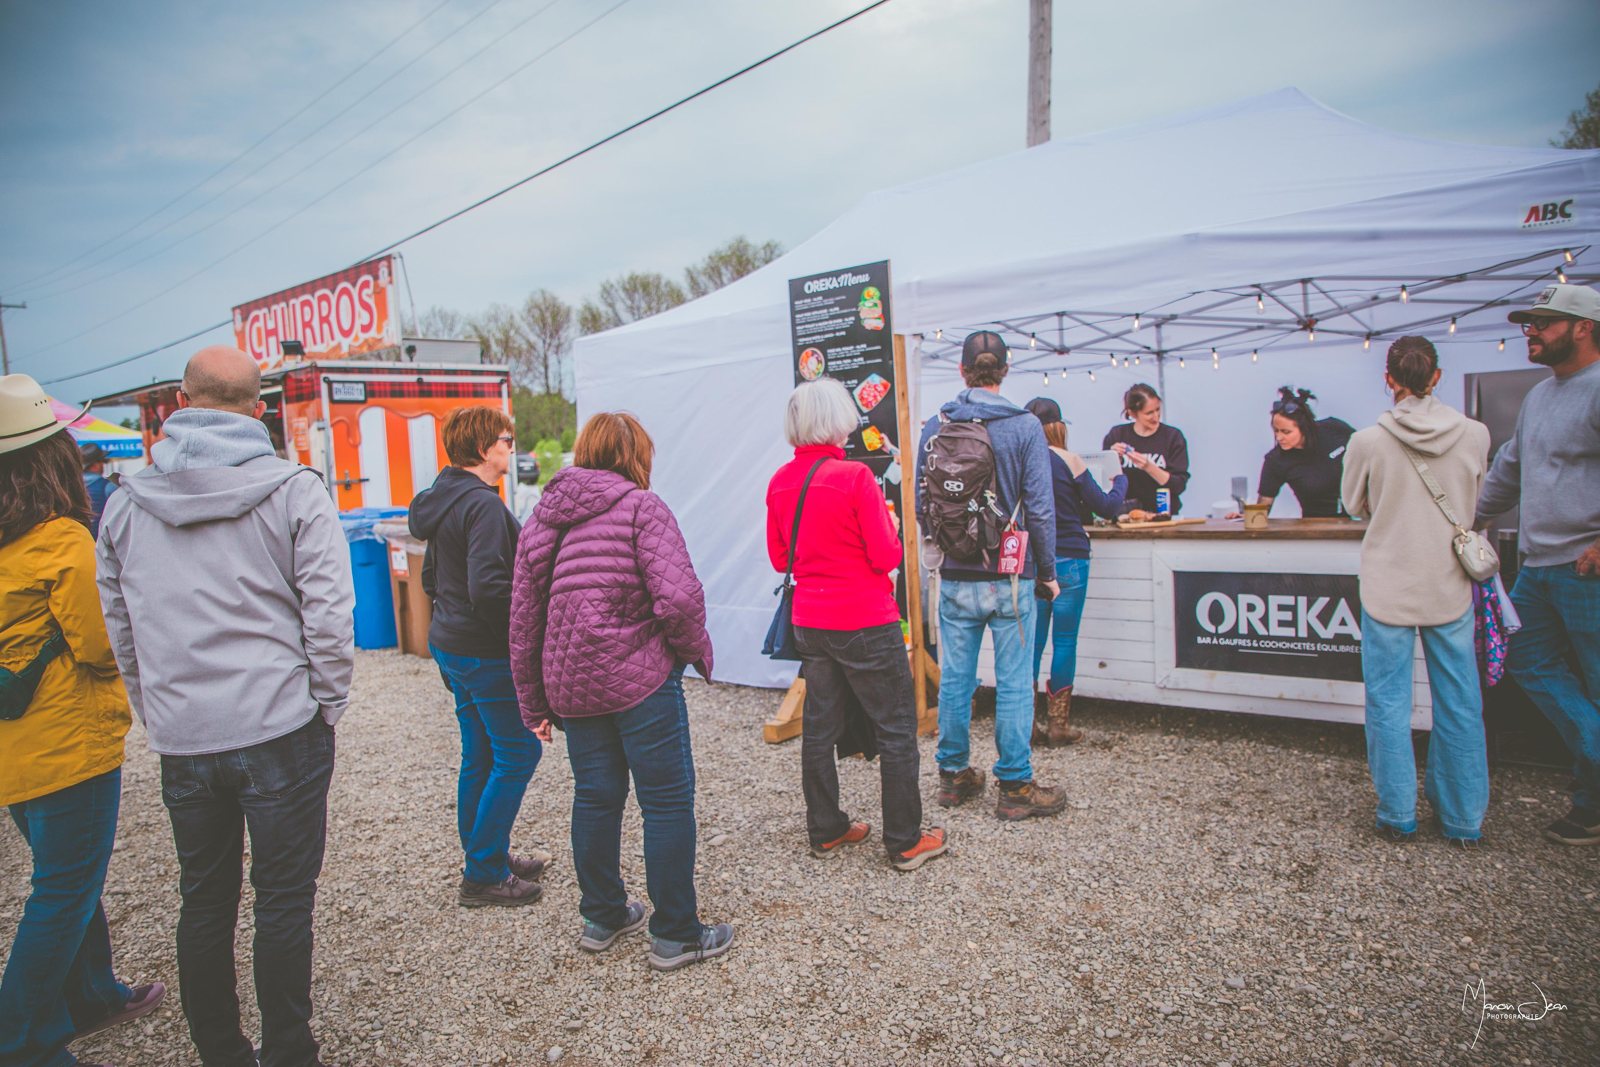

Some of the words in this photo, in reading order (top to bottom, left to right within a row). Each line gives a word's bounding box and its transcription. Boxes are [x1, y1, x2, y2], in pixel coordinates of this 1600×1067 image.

[1524, 199, 1573, 223] ABC
[803, 277, 840, 294] OREKA
[838, 272, 871, 287] Menu
[248, 278, 375, 361] CHURROS
[1196, 591, 1363, 641] OREKA
[1196, 636, 1212, 645] BAR
[1211, 635, 1219, 645] À
[1219, 637, 1252, 647] GAUFRES
[1252, 639, 1259, 648] &
[1258, 640, 1316, 652] COCHONCETÉS
